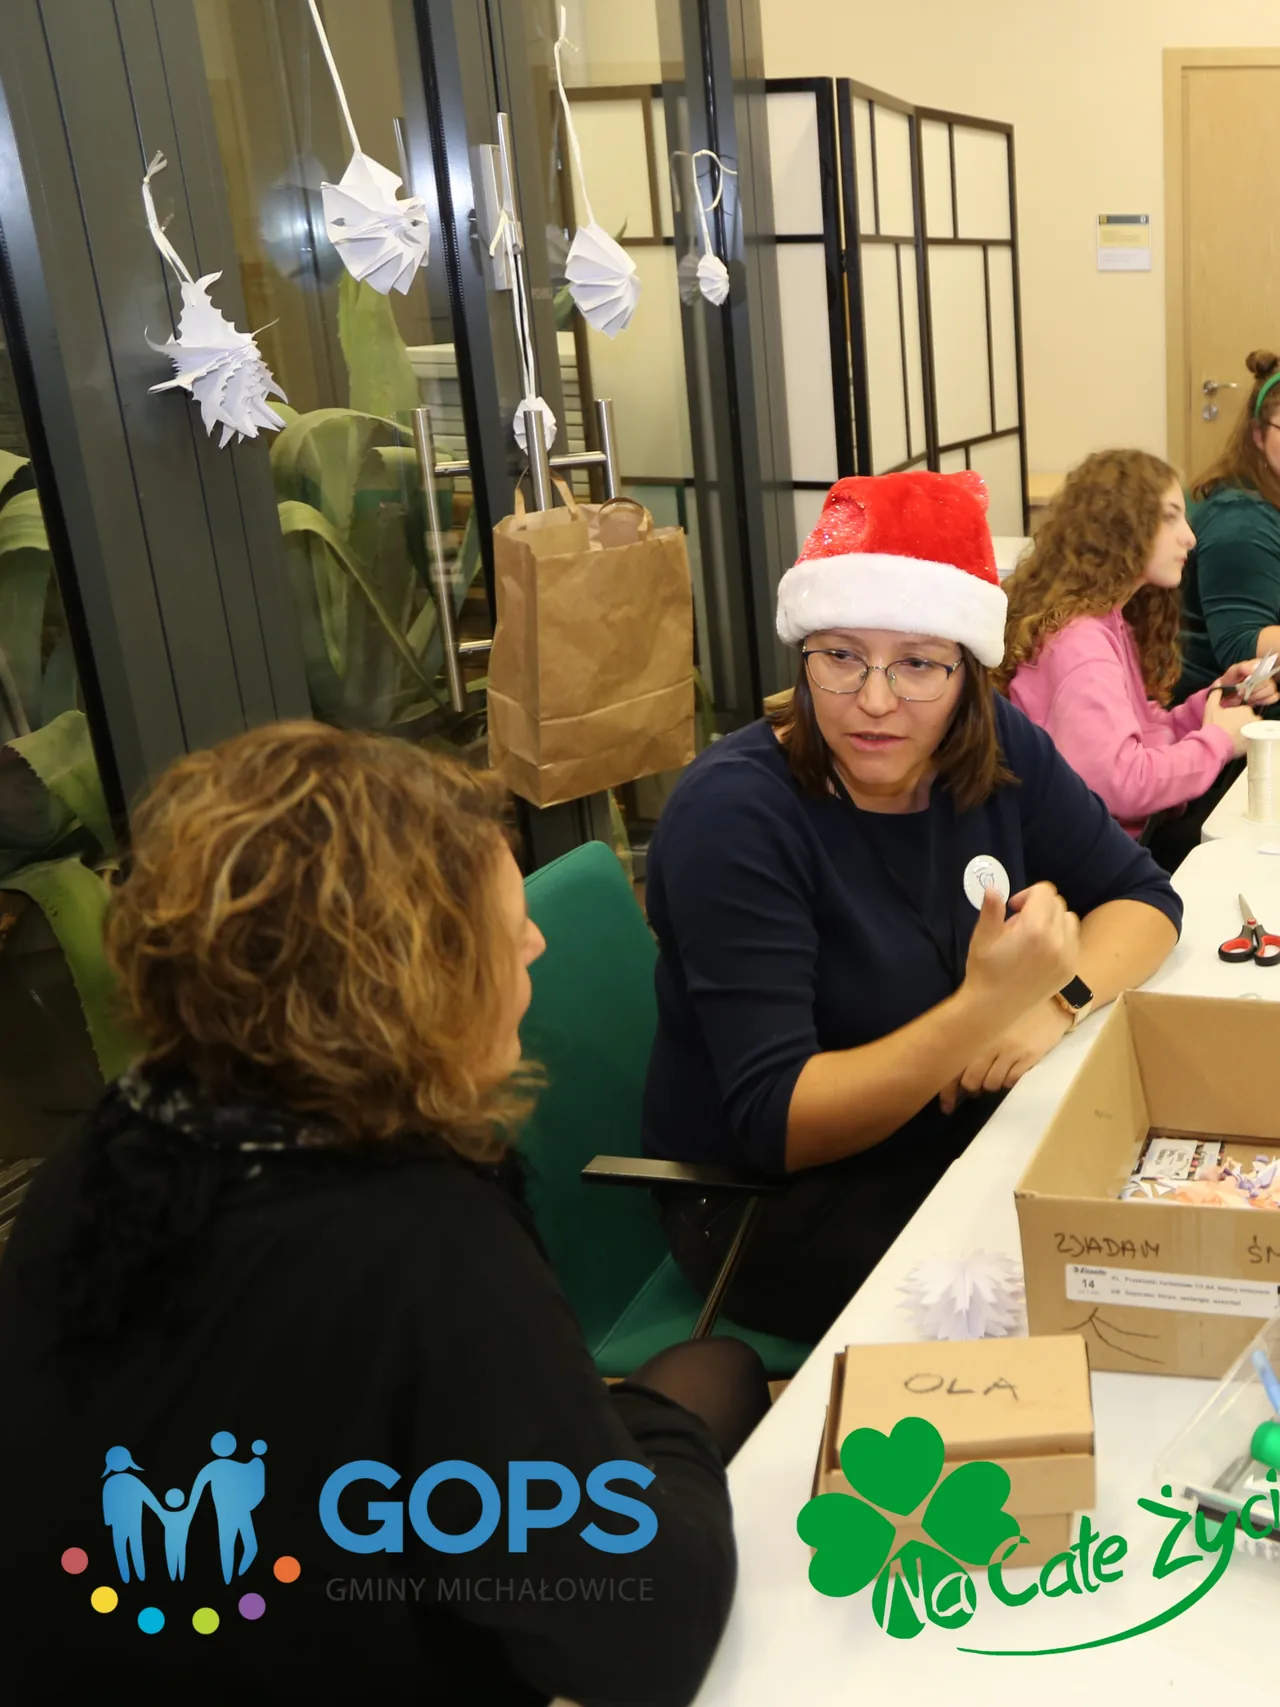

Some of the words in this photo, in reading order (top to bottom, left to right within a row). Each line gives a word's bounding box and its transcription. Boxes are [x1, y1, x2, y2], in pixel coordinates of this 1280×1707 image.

[1054, 1232, 1160, 1259] ZJADAM
[1082, 1278, 1095, 1289] 14
[904, 1372, 1019, 1401] OLA
